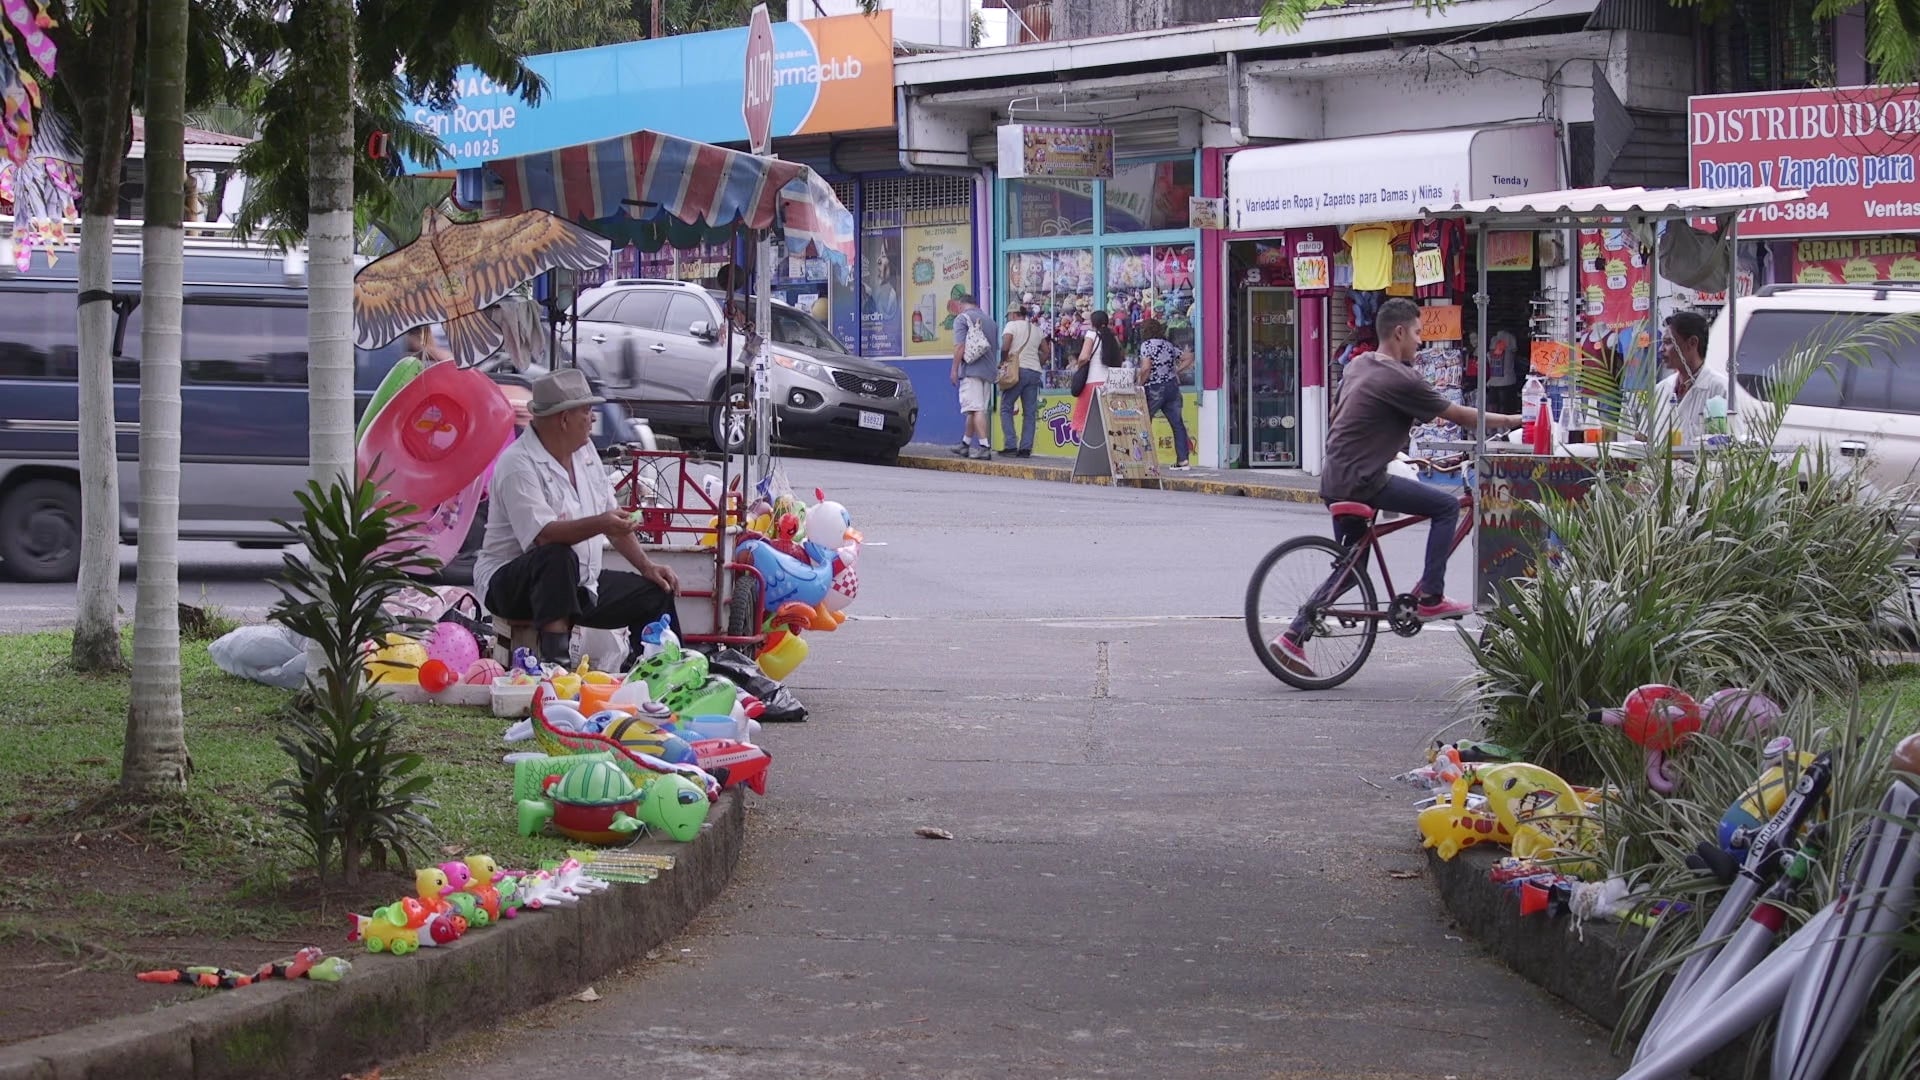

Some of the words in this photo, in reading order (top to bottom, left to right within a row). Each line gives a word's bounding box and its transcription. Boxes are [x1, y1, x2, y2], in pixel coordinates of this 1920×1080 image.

[746, 50, 772, 109] ALTO
[773, 55, 862, 87] armaclub
[414, 109, 449, 136] San
[454, 105, 516, 137] Roque
[1492, 174, 1521, 185] Tienda
[1523, 177, 1529, 187] y
[1779, 153, 1859, 191] Zapatos
[1863, 153, 1914, 188] para
[1245, 195, 1280, 212] Variedad
[1282, 198, 1292, 210] en
[1293, 194, 1313, 211] Ropa
[1315, 197, 1320, 211] y
[1323, 192, 1356, 209] Zapatos
[1359, 192, 1377, 207] para
[1380, 187, 1408, 202] Damas
[1411, 191, 1417, 204] y
[1418, 184, 1443, 200] Niñas
[1798, 239, 1854, 262] GRAN
[1859, 238, 1917, 257] FERIA
